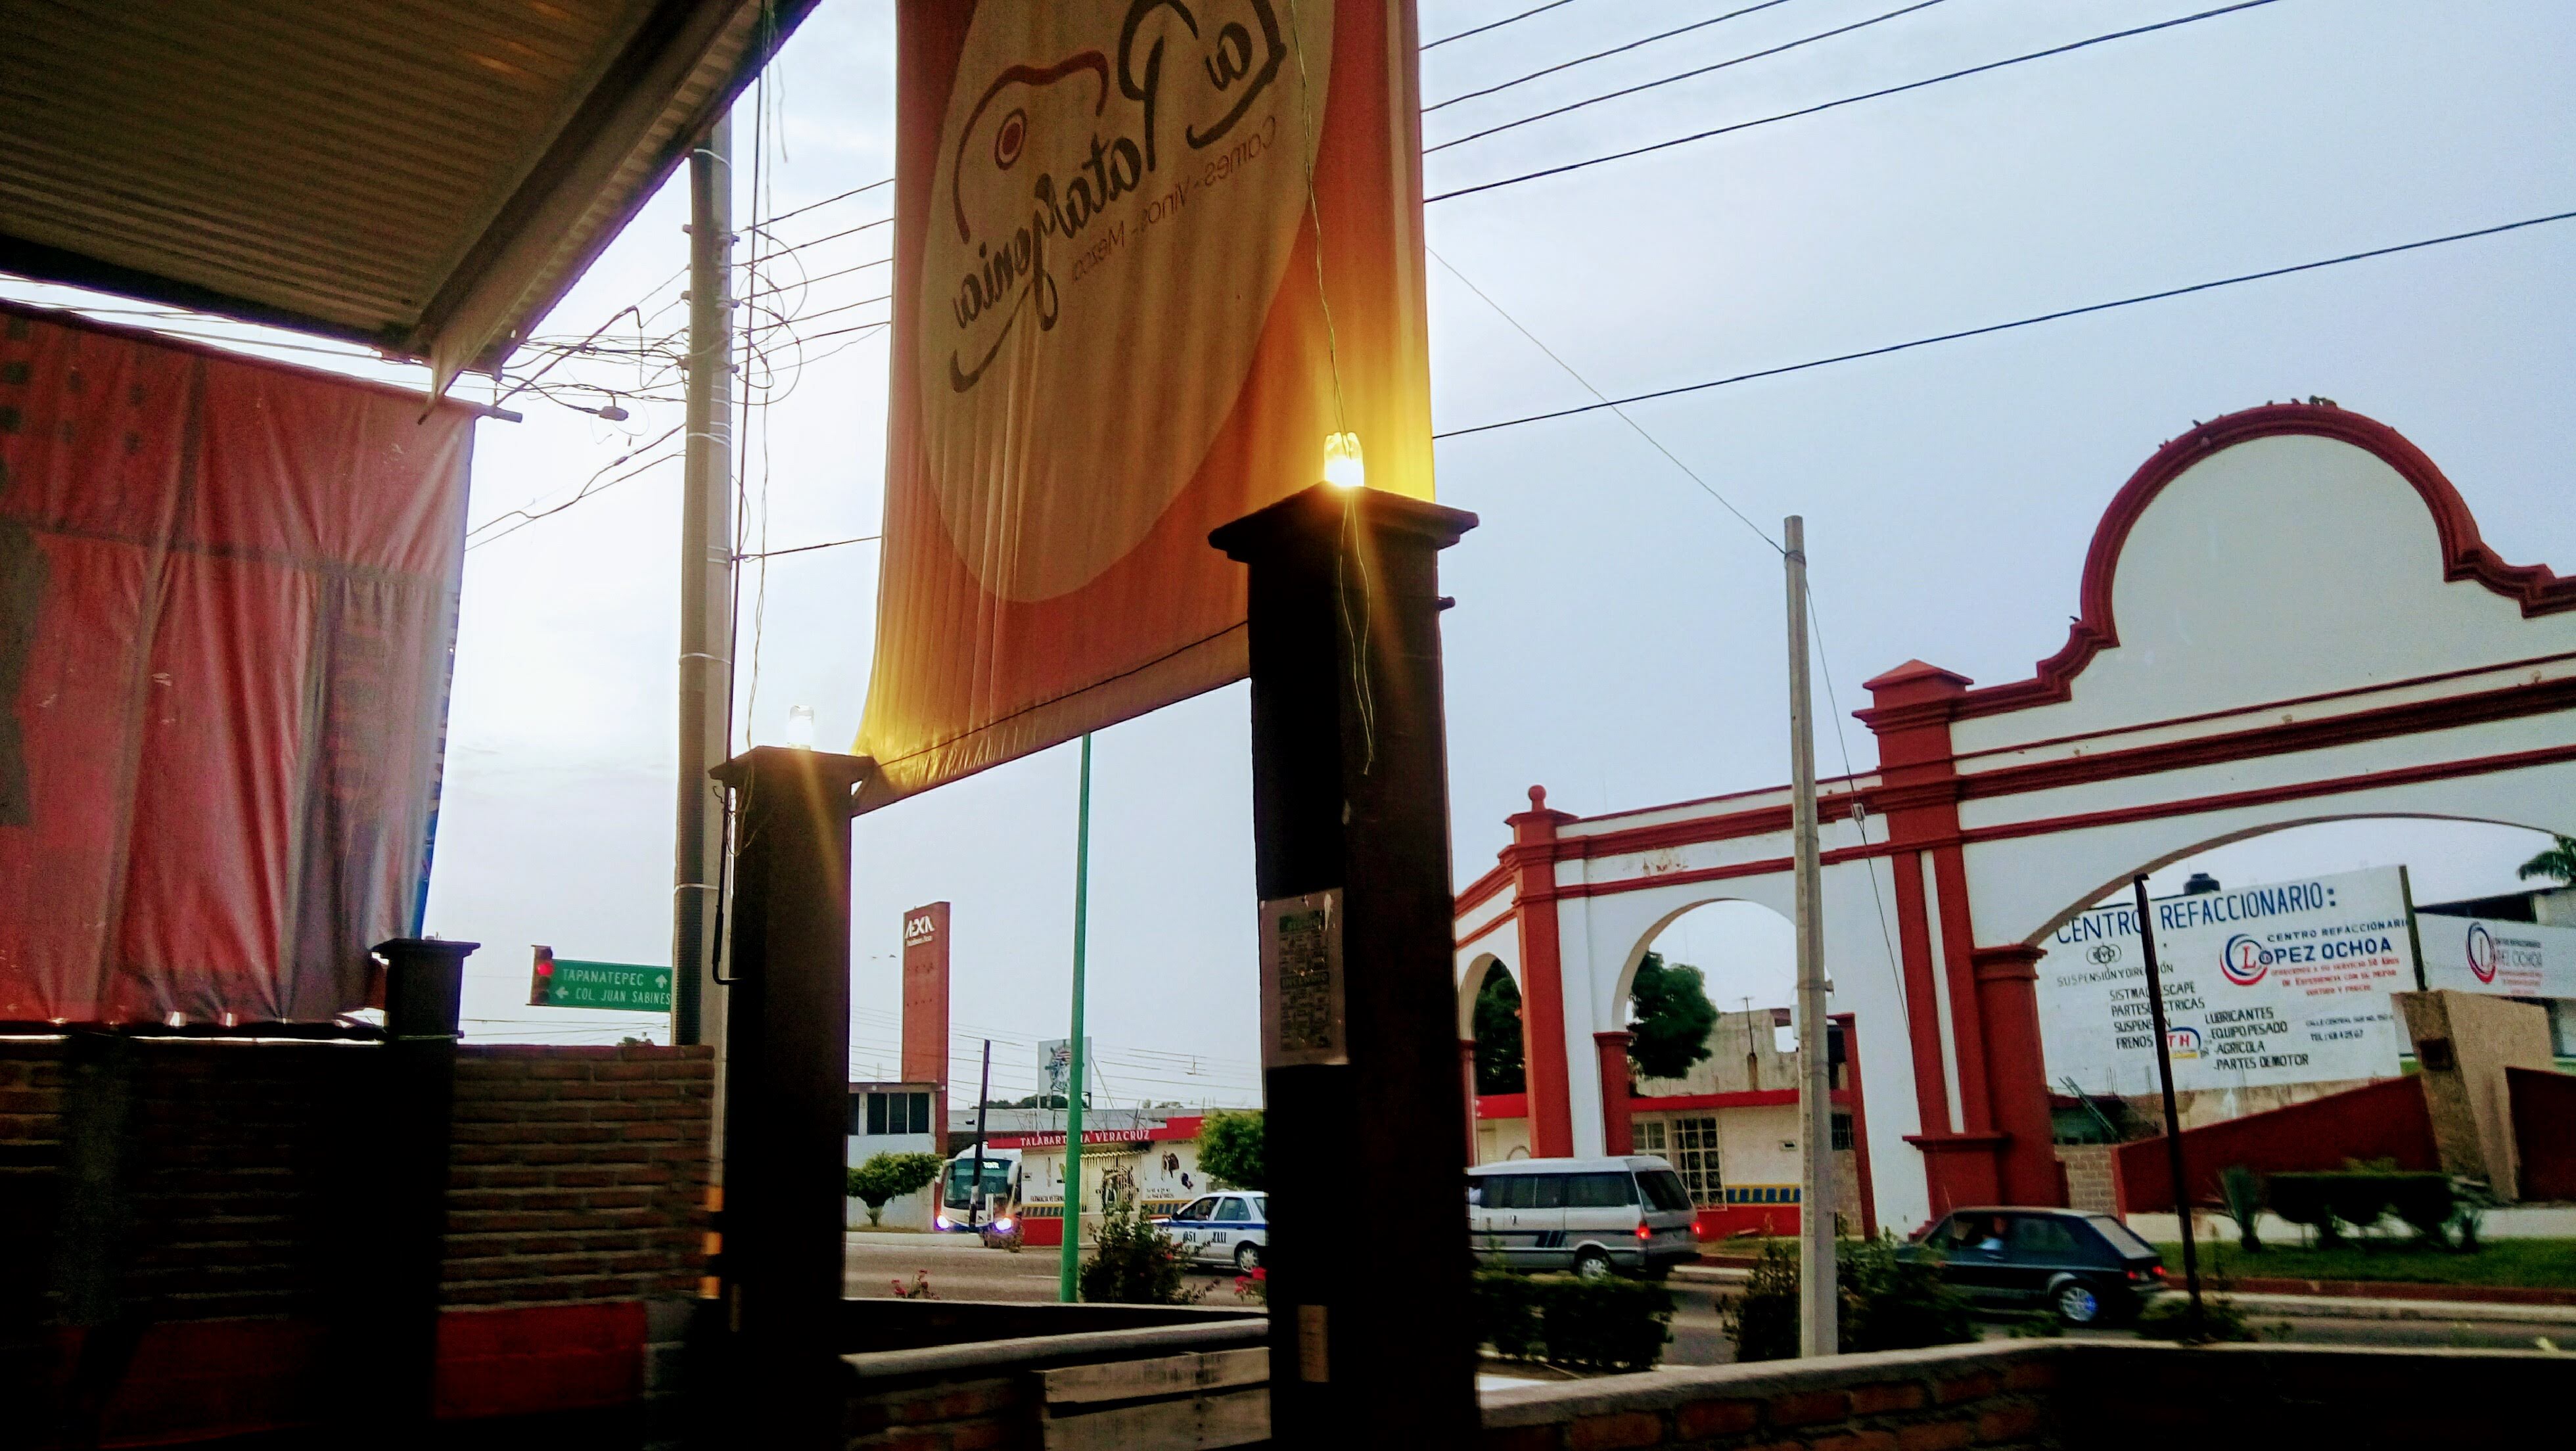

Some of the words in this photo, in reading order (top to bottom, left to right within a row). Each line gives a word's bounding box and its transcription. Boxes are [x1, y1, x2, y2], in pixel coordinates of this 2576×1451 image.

[2267, 929, 2317, 942] CENTRO
[2322, 936, 2392, 960] OCHOA
[563, 969, 644, 986] TAPANATEPEC
[2163, 980, 2196, 996] SCAPE
[601, 989, 626, 1002] JUAN
[632, 990, 670, 1005] SABINES
[2114, 1017, 2171, 1032] SUSPENSN
[2247, 1021, 2288, 1036] PESADO
[2116, 1034, 2153, 1049] FRENOS
[1095, 1130, 1149, 1143] VERACRUZ
